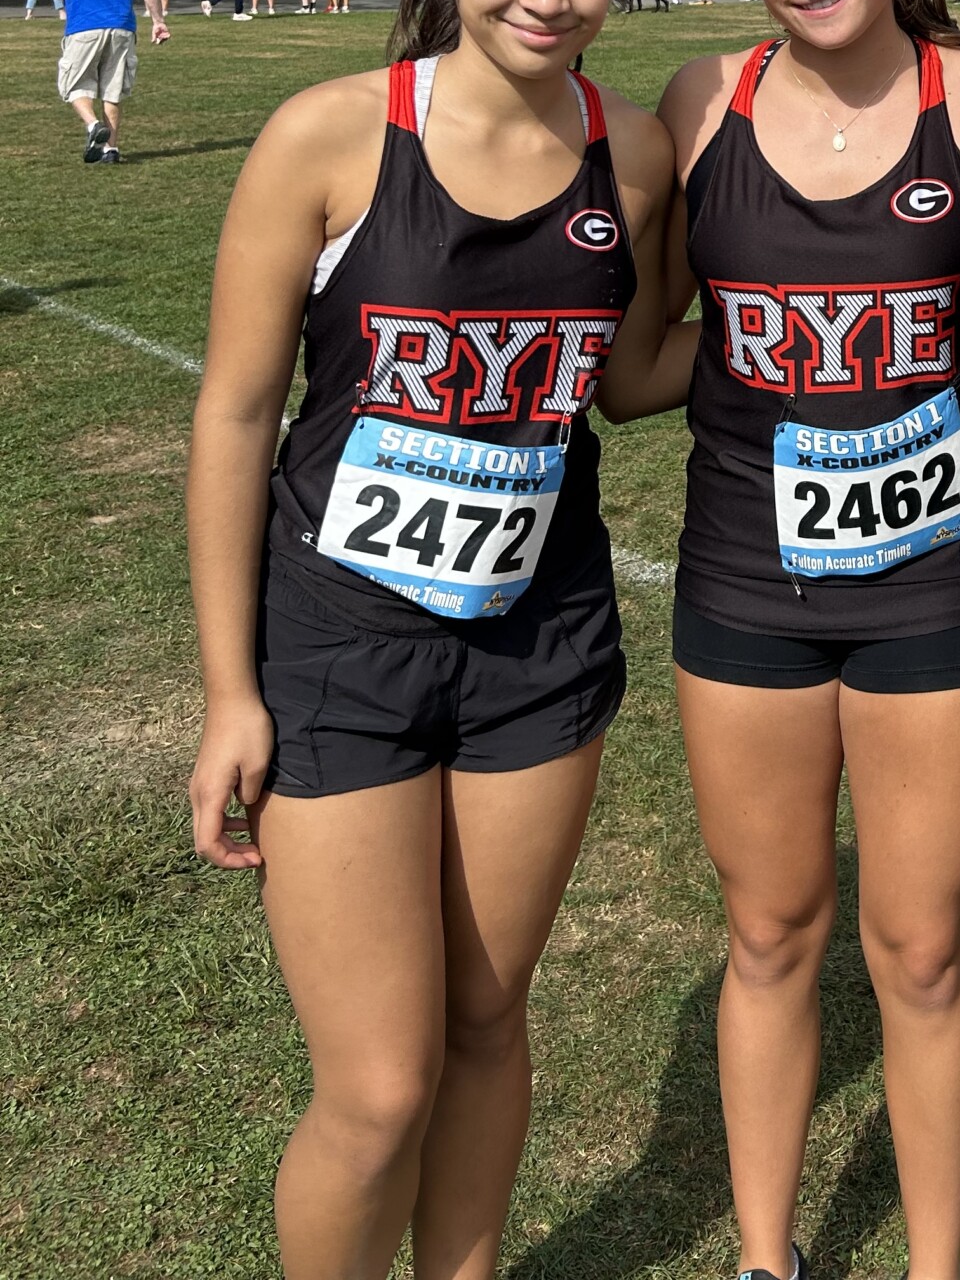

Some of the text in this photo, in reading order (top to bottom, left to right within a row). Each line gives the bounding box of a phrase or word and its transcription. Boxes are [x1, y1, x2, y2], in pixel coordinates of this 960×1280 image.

[711, 278, 960, 390] RYE
[358, 310, 619, 418] RYE
[379, 426, 548, 475] SECTION 1
[796, 402, 943, 455] SECTION 1
[796, 423, 945, 470] X-COUNTRY
[372, 453, 547, 492] X-COUNTRY
[343, 484, 538, 575] 2472
[791, 542, 912, 571] Fulton Accurate Timing
[422, 586, 465, 613] Timing
